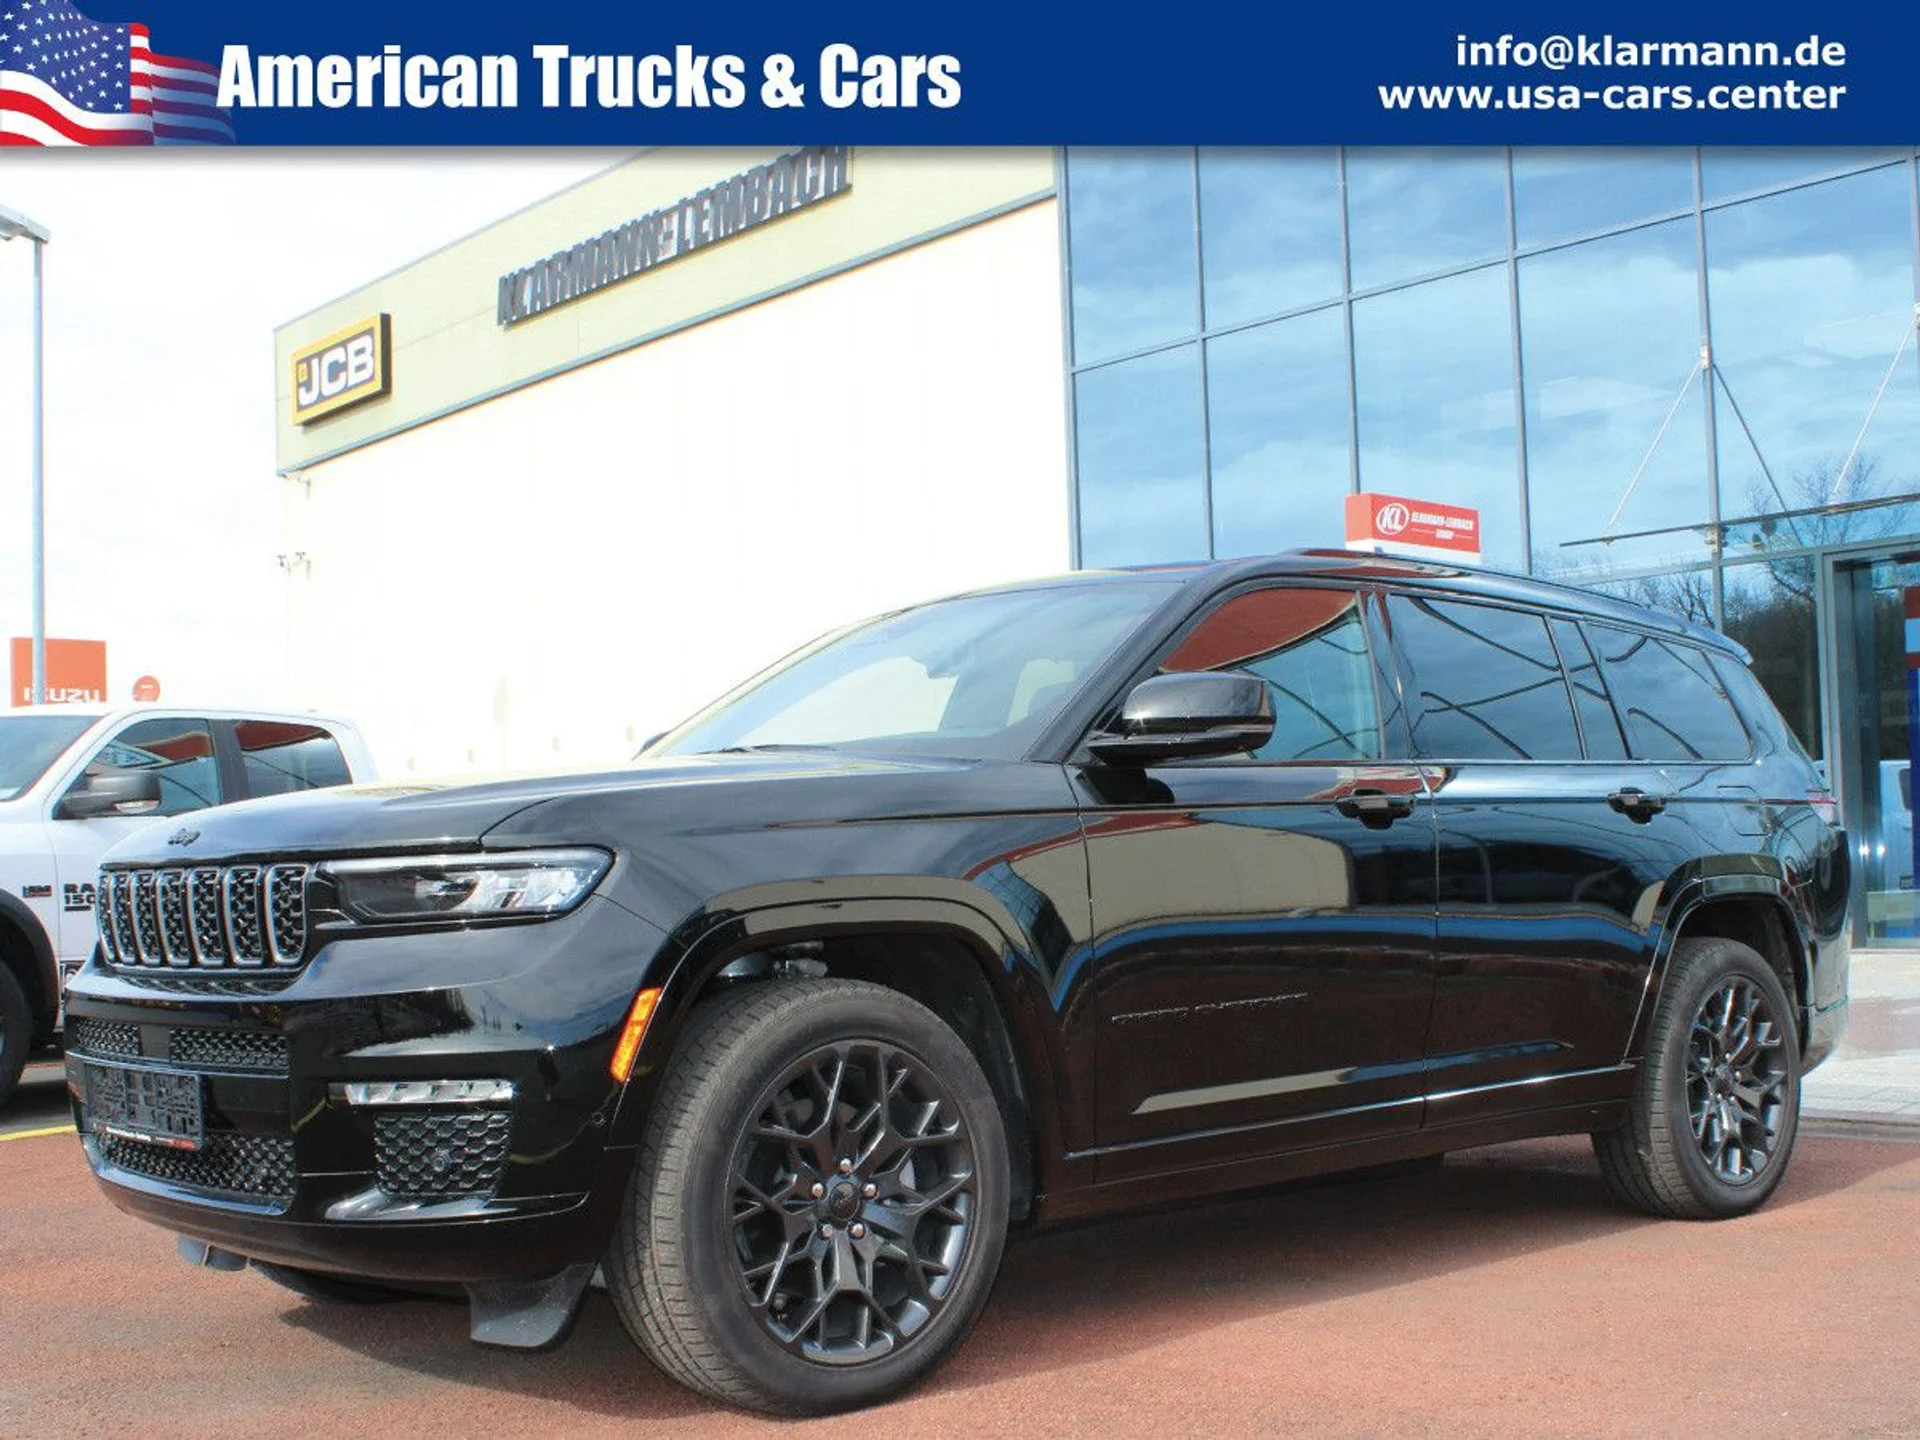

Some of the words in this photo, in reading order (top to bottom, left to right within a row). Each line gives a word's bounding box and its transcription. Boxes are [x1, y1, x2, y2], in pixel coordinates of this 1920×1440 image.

[298, 334, 375, 406] JCB
[24, 687, 101, 703] IUZU
[64, 884, 96, 893] RA
